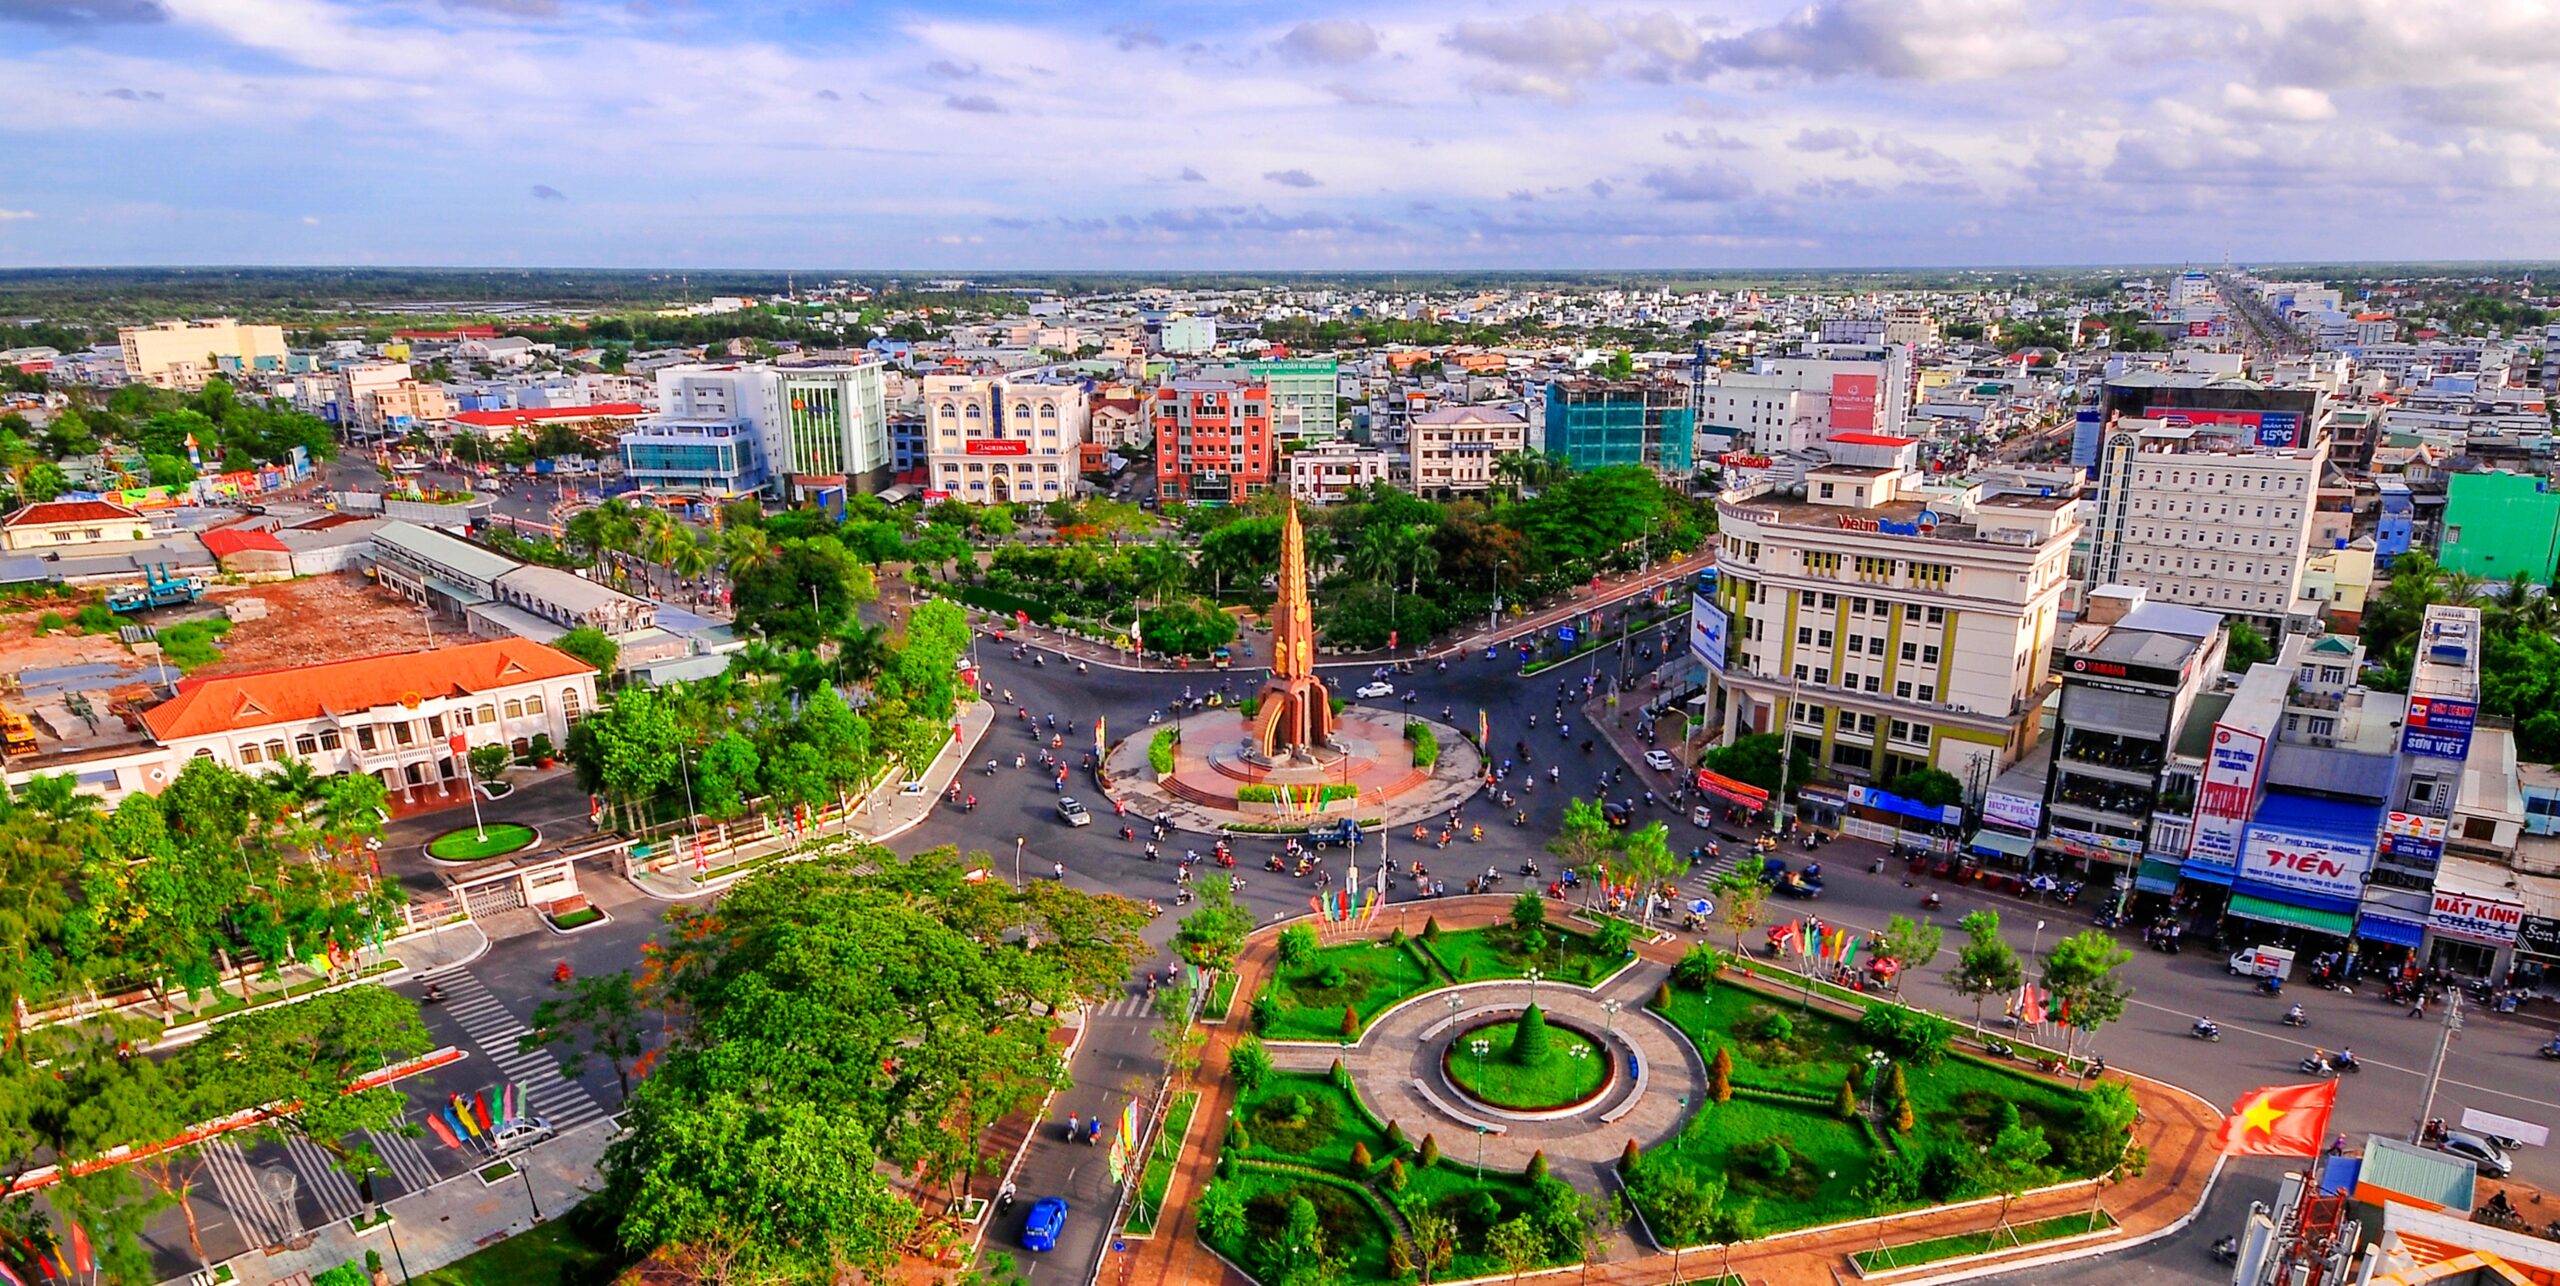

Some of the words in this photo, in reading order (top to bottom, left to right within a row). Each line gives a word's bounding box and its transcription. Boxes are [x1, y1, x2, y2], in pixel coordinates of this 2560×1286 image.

[2087, 661, 2127, 677] YAMAHA
[2214, 747, 2232, 760] PHỤ
[2407, 737, 2432, 751] SƠN
[2435, 741, 2463, 755] VIỆT
[1988, 801, 2009, 812] HUY
[2285, 837, 2302, 848] PHỤ
[2331, 844, 2361, 855] HONDA
[2396, 844, 2415, 855] SƠN
[2416, 847, 2433, 858] VIỆT
[2434, 897, 2472, 916] MẮT
[2475, 903, 2520, 925] KÍNH
[2526, 925, 2554, 942] Sơn
